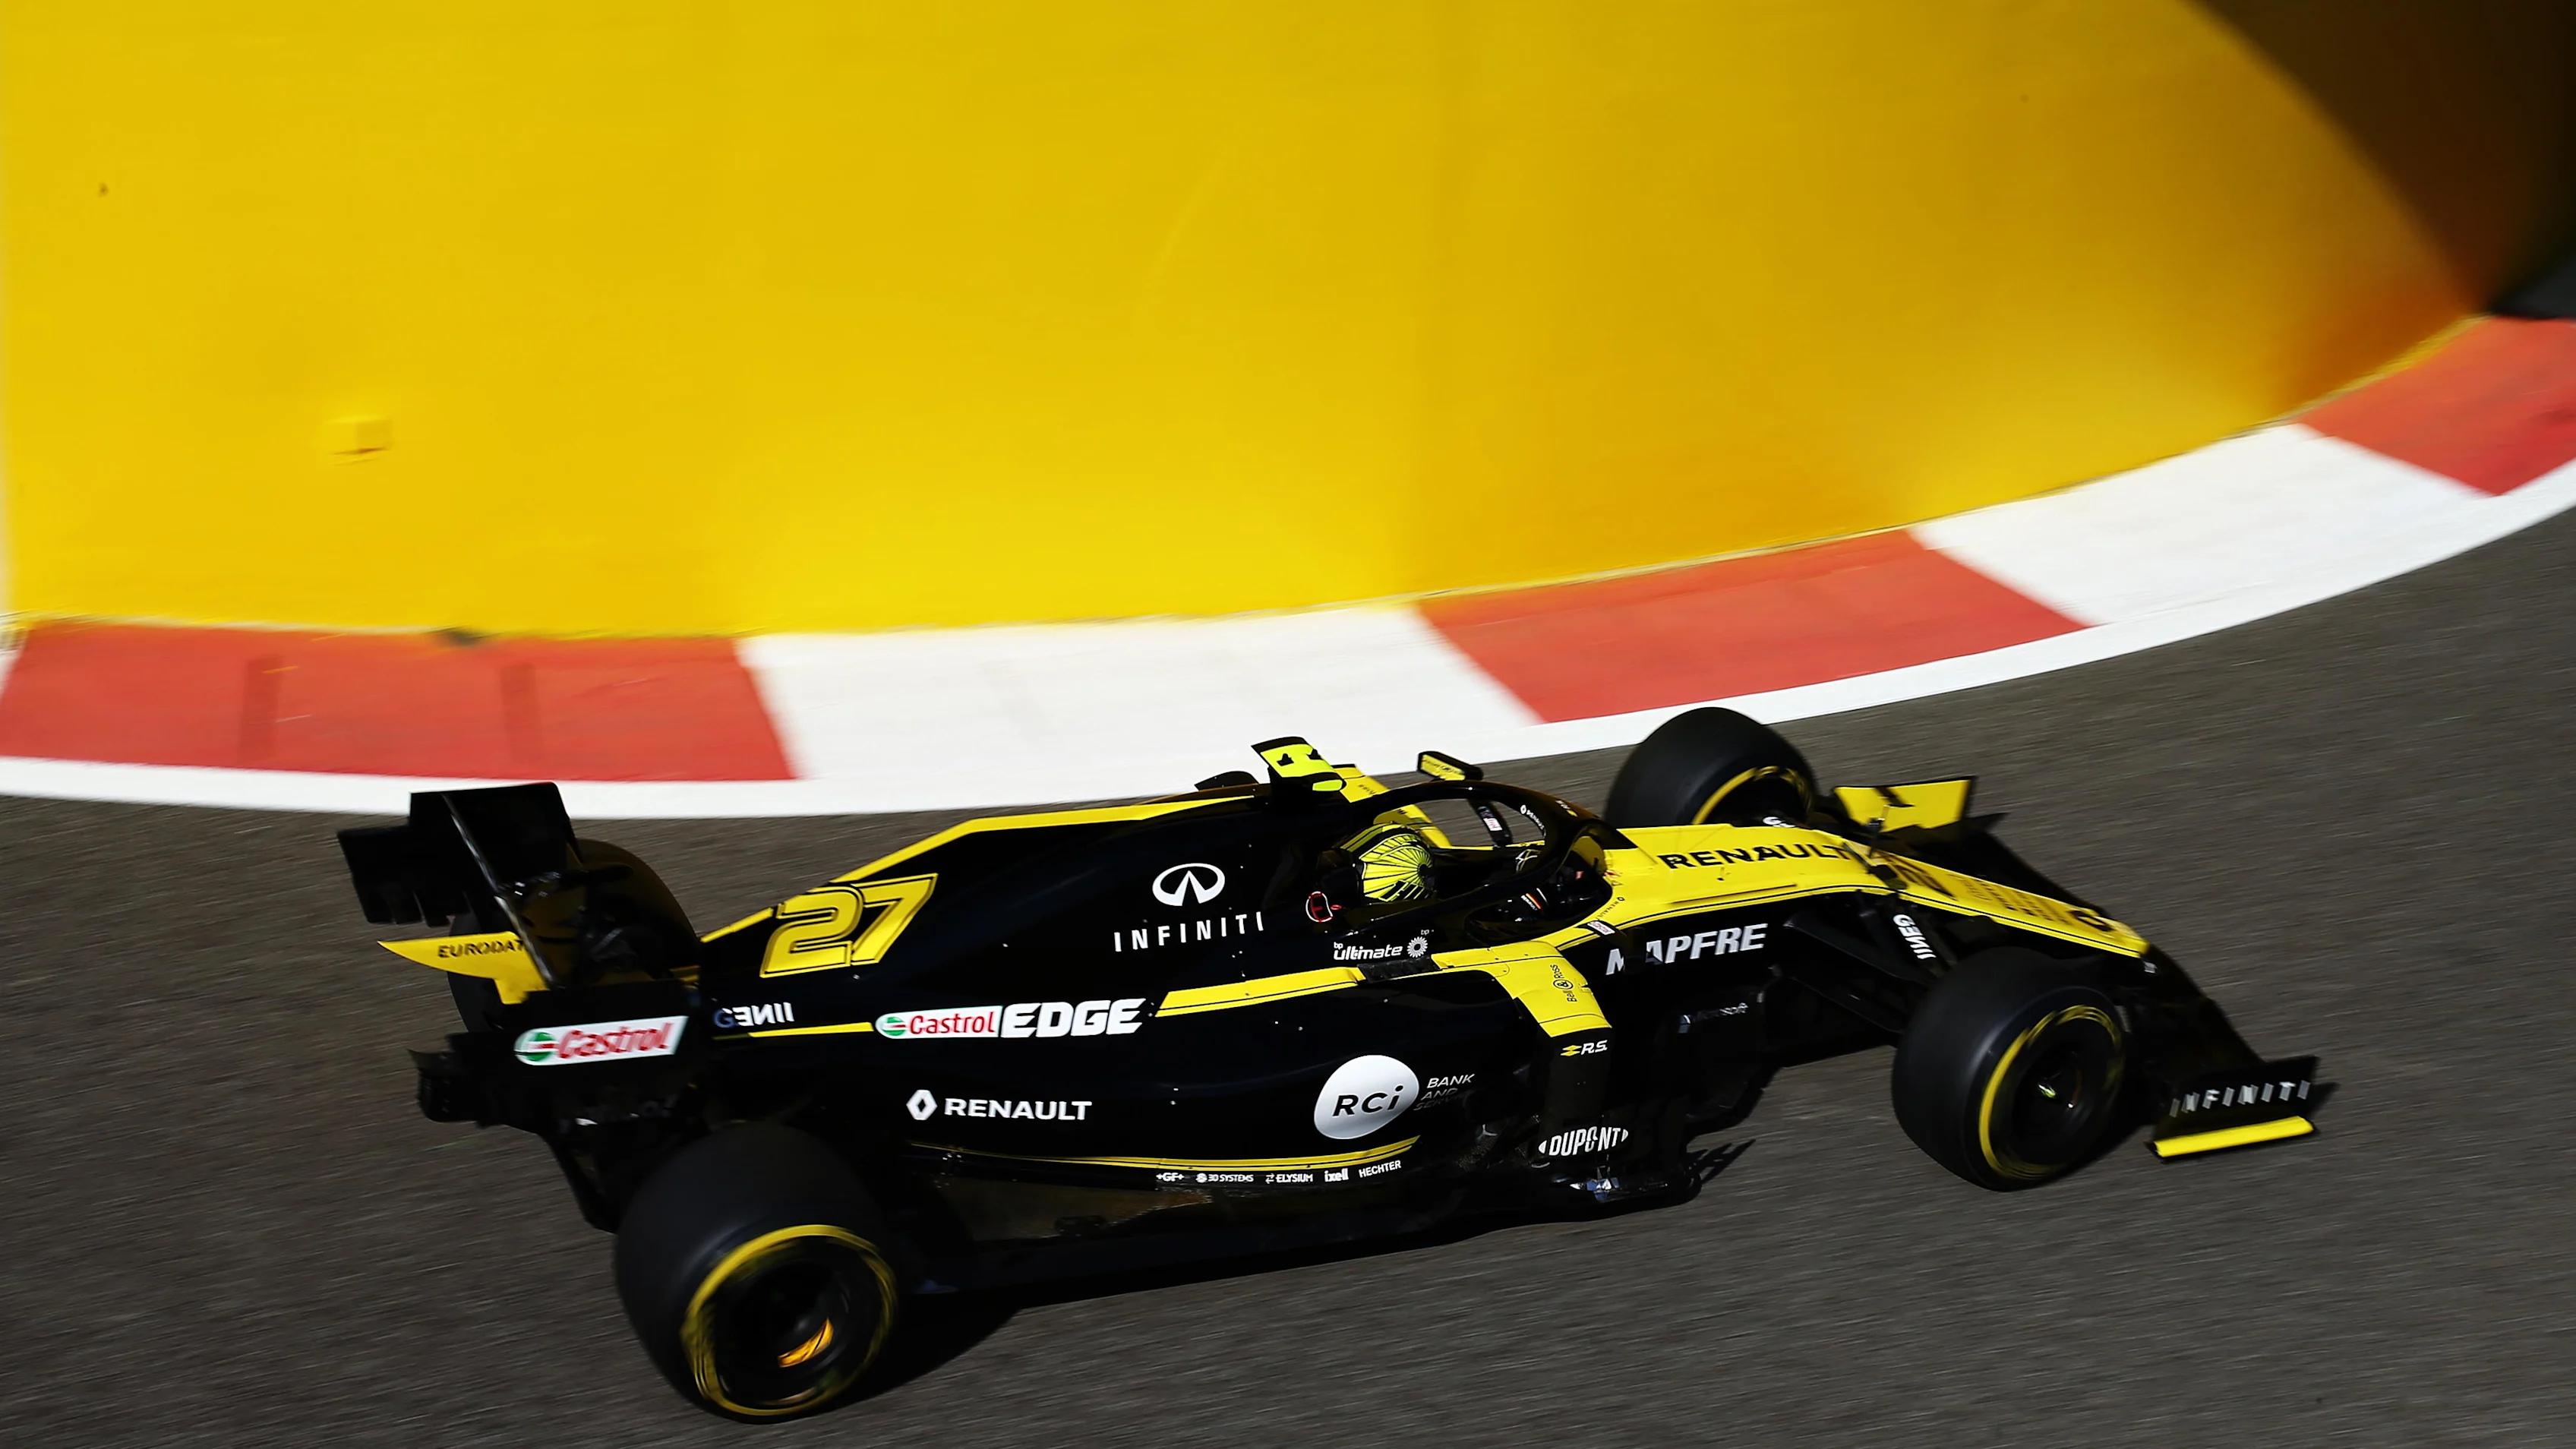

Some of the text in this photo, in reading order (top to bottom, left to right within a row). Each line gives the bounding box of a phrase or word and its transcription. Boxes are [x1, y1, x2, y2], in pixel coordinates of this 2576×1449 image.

[1657, 844, 1851, 869] RENAULT
[759, 873, 939, 978] 27
[1114, 912, 1264, 952] INFINITI
[1334, 944, 1403, 960] ultimate
[1605, 923, 1768, 975] MAPFRE
[910, 998, 1146, 1038] Castrol EDGE
[557, 1022, 674, 1059] Castrol
[1427, 1073, 1475, 1088] BANK
[1421, 1088, 1459, 1101] AND
[2170, 1080, 2311, 1117] INFINITI
[944, 1097, 1093, 1121] RENAULT
[1548, 1126, 1621, 1156] DUPONT
[1218, 1173, 1254, 1183] SYSTEMS
[1276, 1173, 1313, 1183] ELYSIUM
[1324, 1168, 1349, 1182] ixell
[1358, 1160, 1401, 1178] HECHTER
